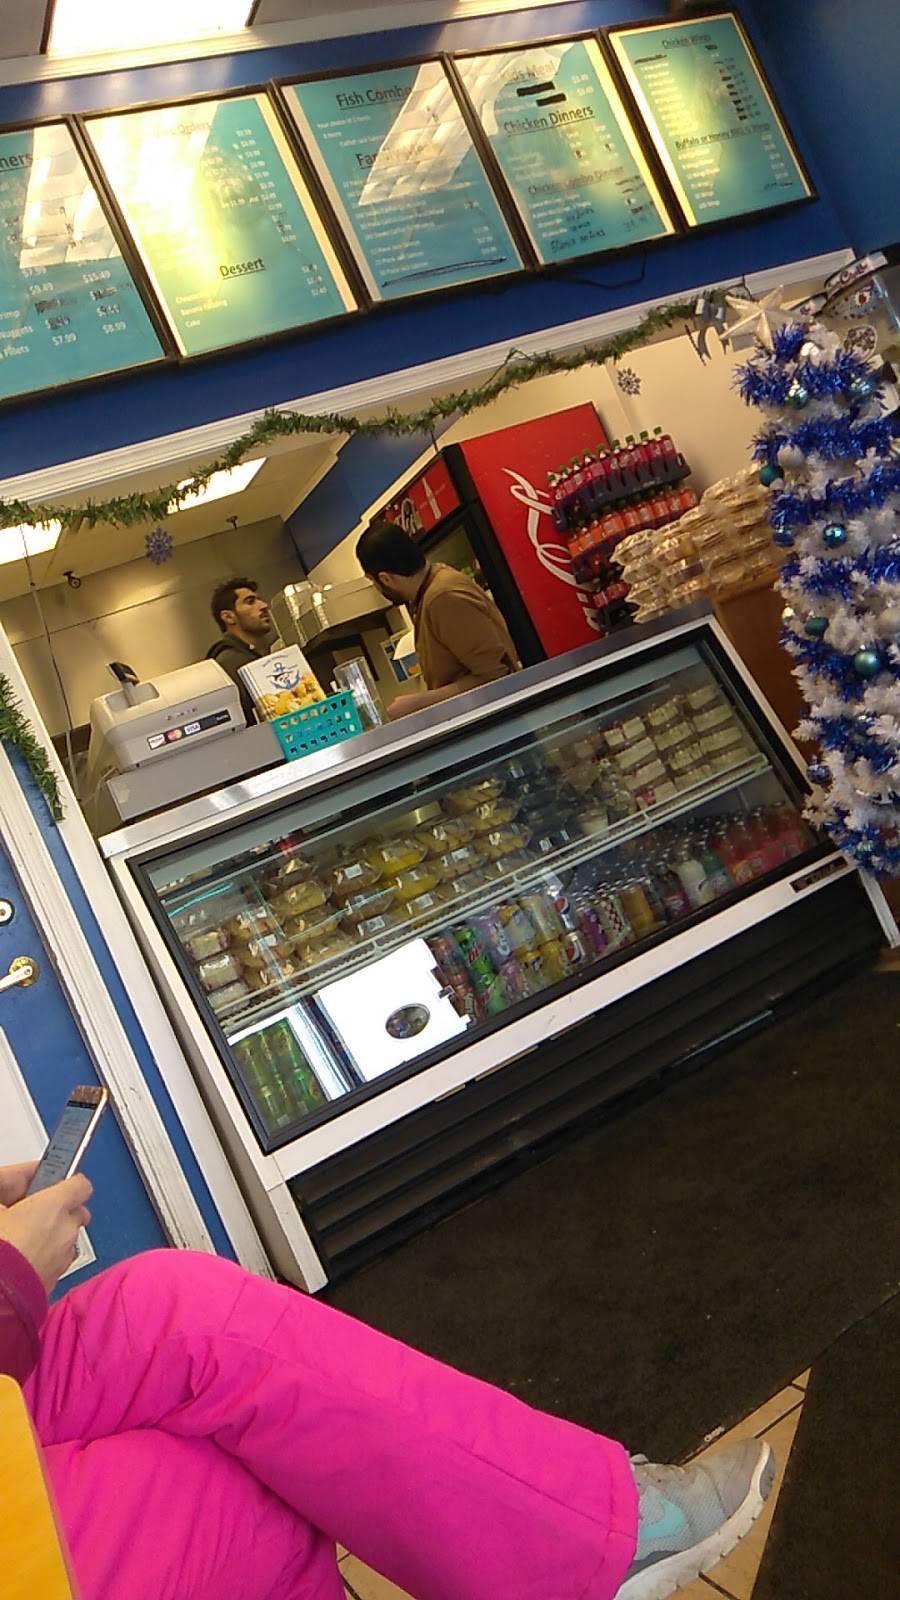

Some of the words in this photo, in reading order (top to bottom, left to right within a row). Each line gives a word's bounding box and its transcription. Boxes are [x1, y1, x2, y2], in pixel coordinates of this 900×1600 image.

[336, 91, 364, 107] Fish
[503, 117, 548, 133] Chicken
[548, 106, 594, 124] Dinners
[219, 257, 265, 277] Dessert
[186, 723, 199, 733] VISA
